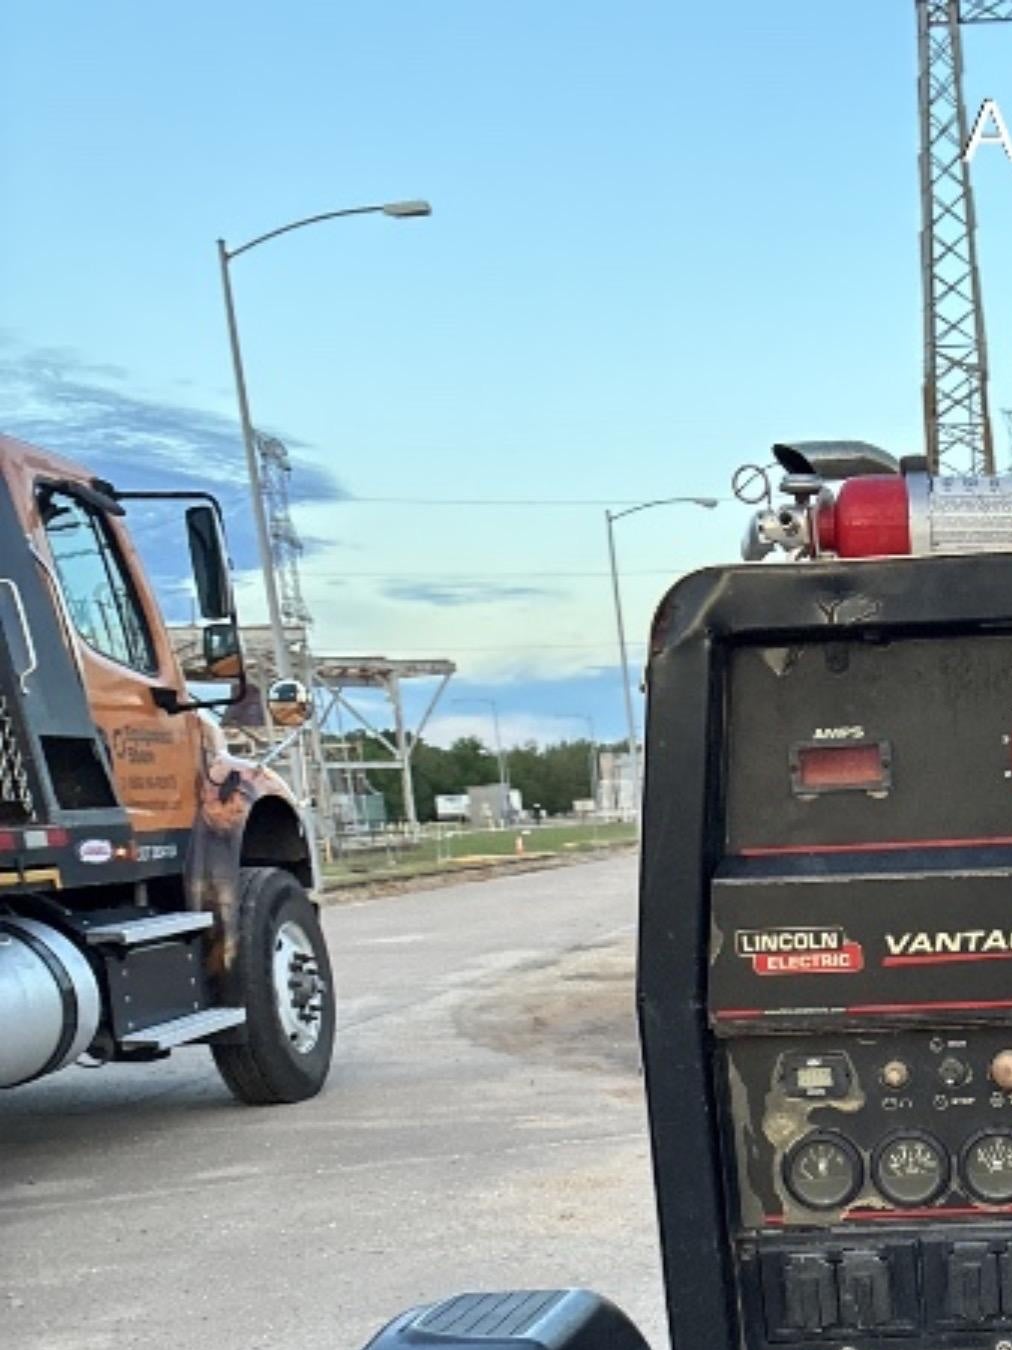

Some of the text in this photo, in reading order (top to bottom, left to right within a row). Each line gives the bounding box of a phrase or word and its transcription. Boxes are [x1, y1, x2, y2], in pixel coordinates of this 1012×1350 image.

[812, 725, 864, 739] AMPS
[741, 931, 838, 952] LINCOLN
[767, 953, 850, 970] ELECTRIC
